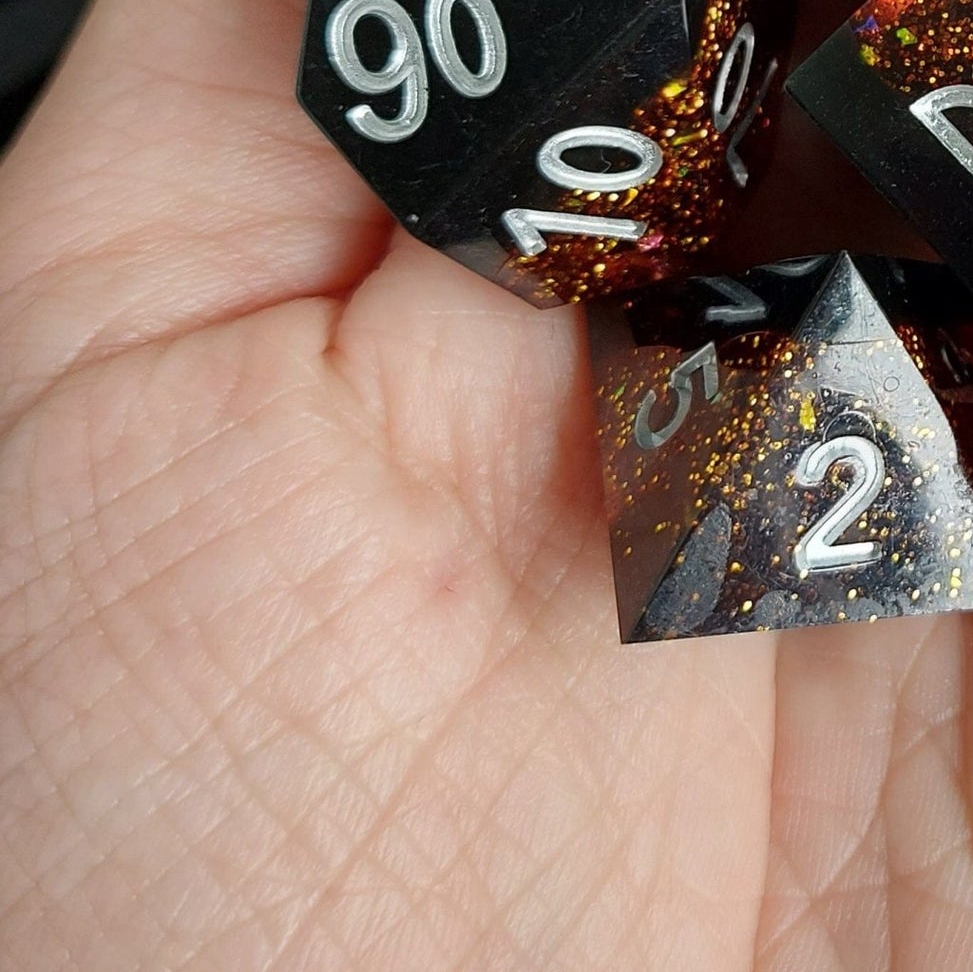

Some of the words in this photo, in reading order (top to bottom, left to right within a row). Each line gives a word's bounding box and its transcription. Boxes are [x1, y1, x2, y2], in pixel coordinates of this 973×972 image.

[502, 125, 664, 257] 10
[634, 341, 720, 451] 5
[794, 434, 885, 572] 2
